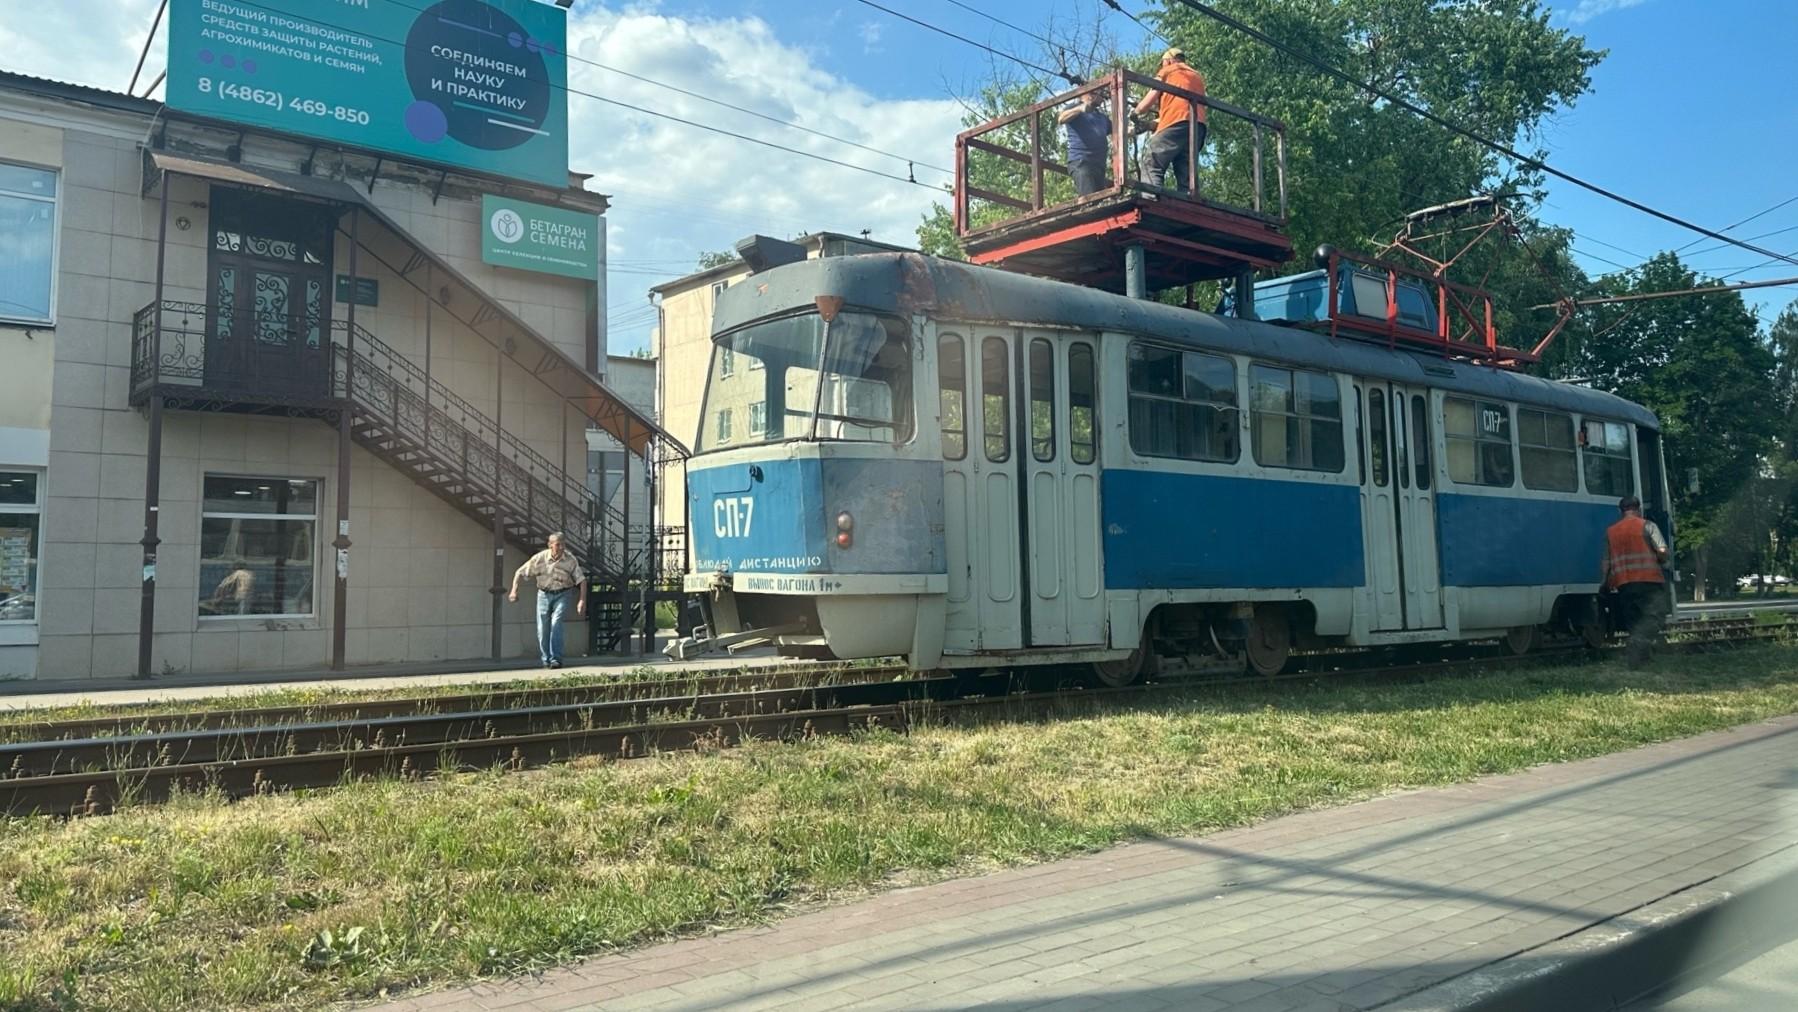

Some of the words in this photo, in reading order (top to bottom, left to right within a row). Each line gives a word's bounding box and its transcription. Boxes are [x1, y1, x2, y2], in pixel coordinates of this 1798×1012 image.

[201, 14, 259, 35] СРЕДСТВ
[262, 28, 316, 49] ЗАЩИТЫ
[319, 42, 383, 65] РАСТЕНИЙ,
[202, 0, 267, 23] ВЕДУЩИЙ
[270, 15, 373, 49] ПРОИЗВОДИТЕЛЬ
[201, 28, 311, 62] АГРОХИМИКАТОВ
[313, 53, 322, 63] И
[325, 57, 365, 74] СЕМЯН
[431, 45, 527, 78] СОЕДИНЯЕМ
[454, 67, 505, 88] НАУКУ
[198, 77, 212, 92] 8
[218, 80, 283, 111] (4862)
[289, 97, 370, 125] 469-850
[431, 78, 442, 91] И
[447, 82, 527, 110] ПРАКТИКУ
[530, 219, 587, 239] БЕТАГРАН
[530, 232, 586, 251] СЕМЕНА
[713, 497, 754, 538] СП-7
[739, 556, 822, 570] ДИСТАНЦИЮ
[777, 578, 815, 592] ВАГОНА
